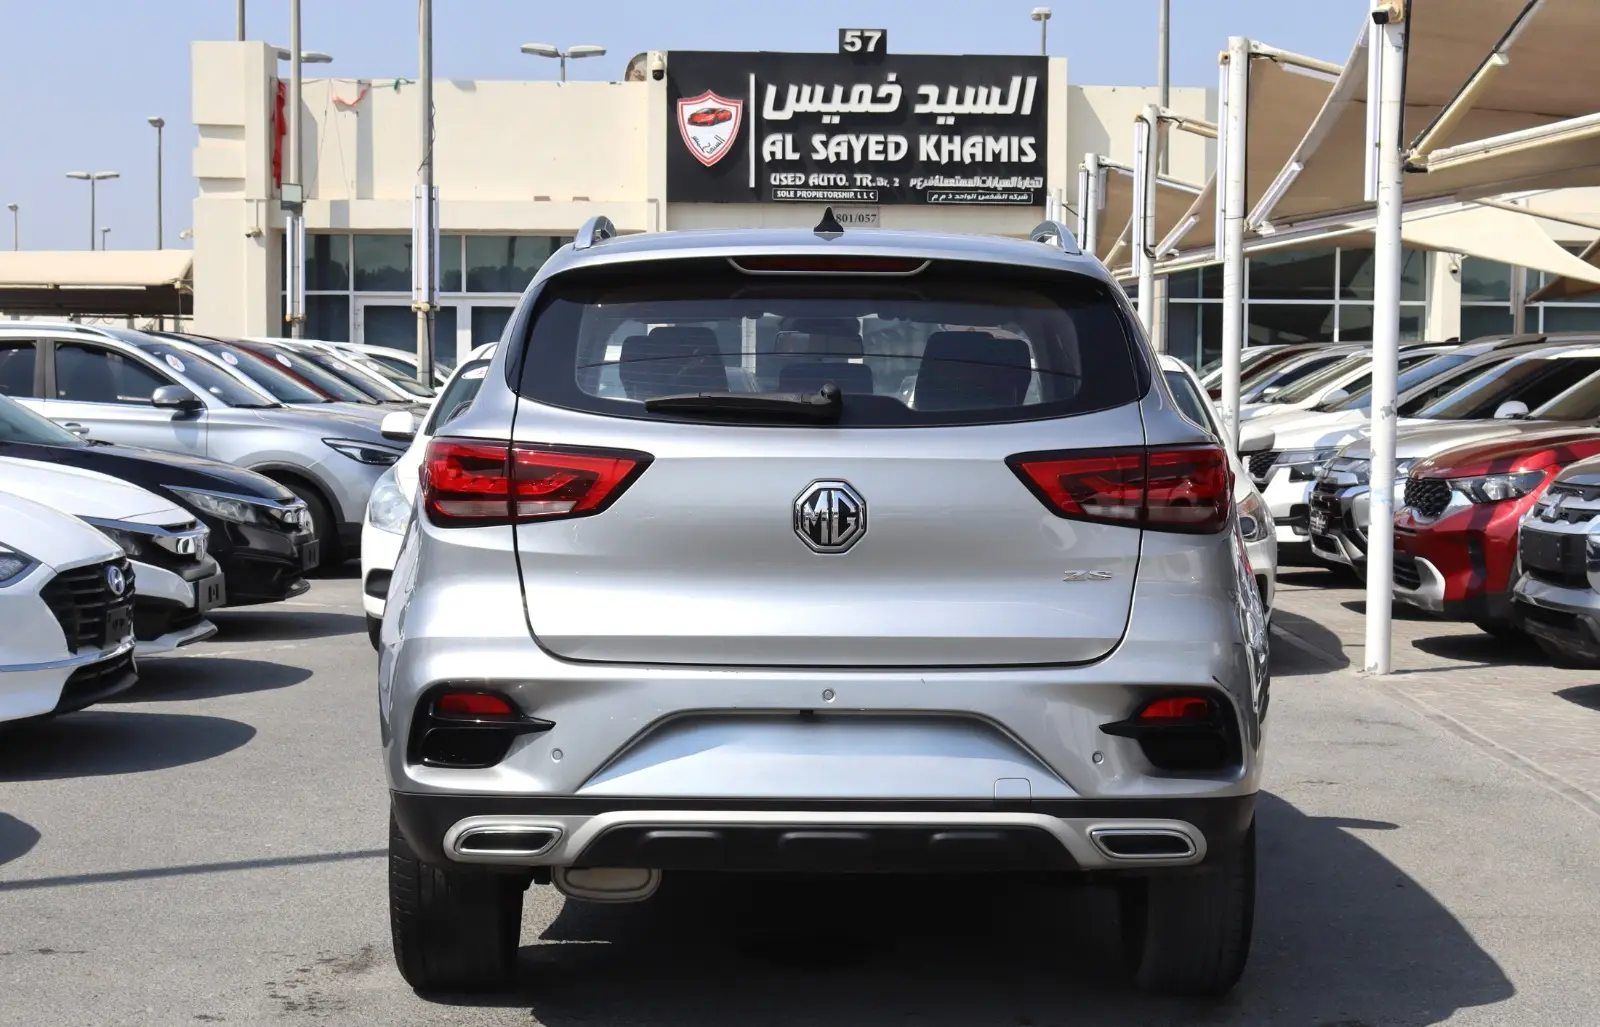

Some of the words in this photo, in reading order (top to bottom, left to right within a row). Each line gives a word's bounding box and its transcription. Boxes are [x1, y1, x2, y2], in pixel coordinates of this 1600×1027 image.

[843, 30, 882, 52] 57
[762, 72, 903, 124] خميس
[914, 75, 1037, 125] السيد
[762, 133, 800, 162] AL
[811, 133, 908, 163] SAYED
[919, 135, 1037, 164] KHAMIS
[770, 172, 805, 185] USED
[808, 173, 849, 186] AUTO.
[893, 177, 900, 187] 2
[777, 190, 795, 198] SOLE
[857, 191, 862, 199] L
[803, 490, 857, 545] MG
